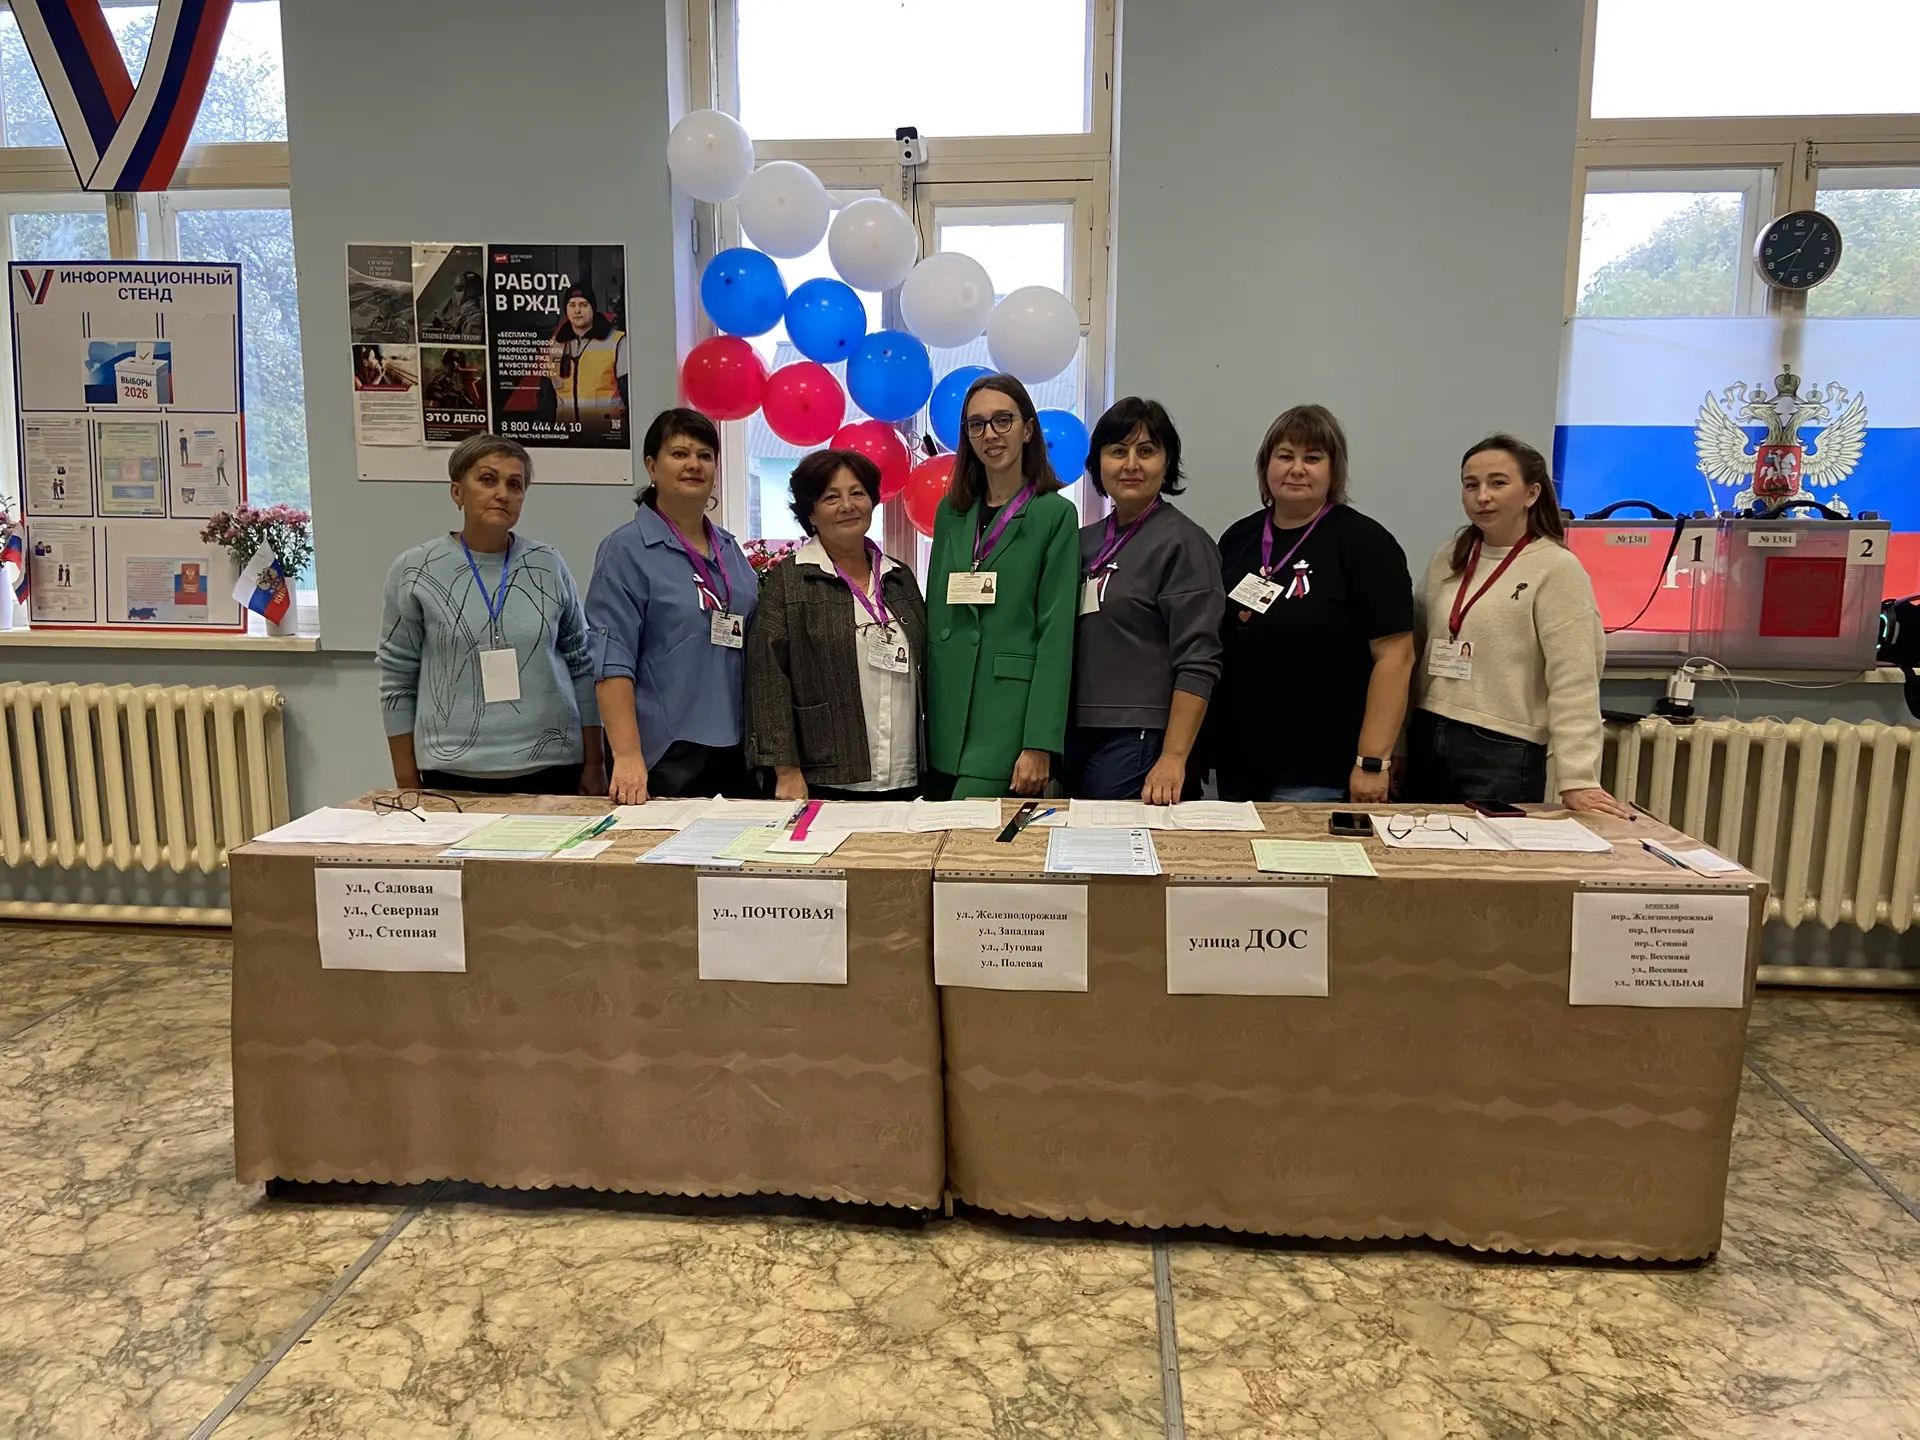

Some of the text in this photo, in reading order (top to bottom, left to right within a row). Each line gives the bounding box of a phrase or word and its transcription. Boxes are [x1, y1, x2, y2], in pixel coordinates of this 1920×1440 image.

[1768, 262, 1775, 270] 8
[60, 270, 233, 286] ИНФОРМАЦИОННЫЙ
[494, 273, 572, 290] РАБОТА
[118, 288, 173, 303] СТЕНД
[495, 294, 560, 315] В РЖД
[121, 376, 152, 387] ВЫБОРЫ
[125, 386, 148, 400] 2026
[426, 412, 486, 424] ЭТО ДЕЛО
[502, 422, 582, 432] 8 800 444 44 10
[1690, 535, 1704, 562] 1
[1860, 539, 1873, 557] 2
[346, 881, 433, 895] ул., Садовая
[344, 904, 439, 918] ул., Северная
[712, 906, 834, 920] ул., ПОЧТОВАЯ
[956, 910, 1068, 921] ул., Железнодорожная
[348, 926, 437, 940] ул., Степная
[978, 927, 1045, 936] ул., Западная
[1650, 926, 1694, 934] Почтовый
[1189, 928, 1308, 952] улица ДОС
[1655, 940, 1687, 948] Сенной
[981, 943, 1043, 953] ул., Луговая
[981, 958, 1043, 968] ул., Полевая
[1634, 979, 1704, 988] ВОКЗАЛЬНАЯ
